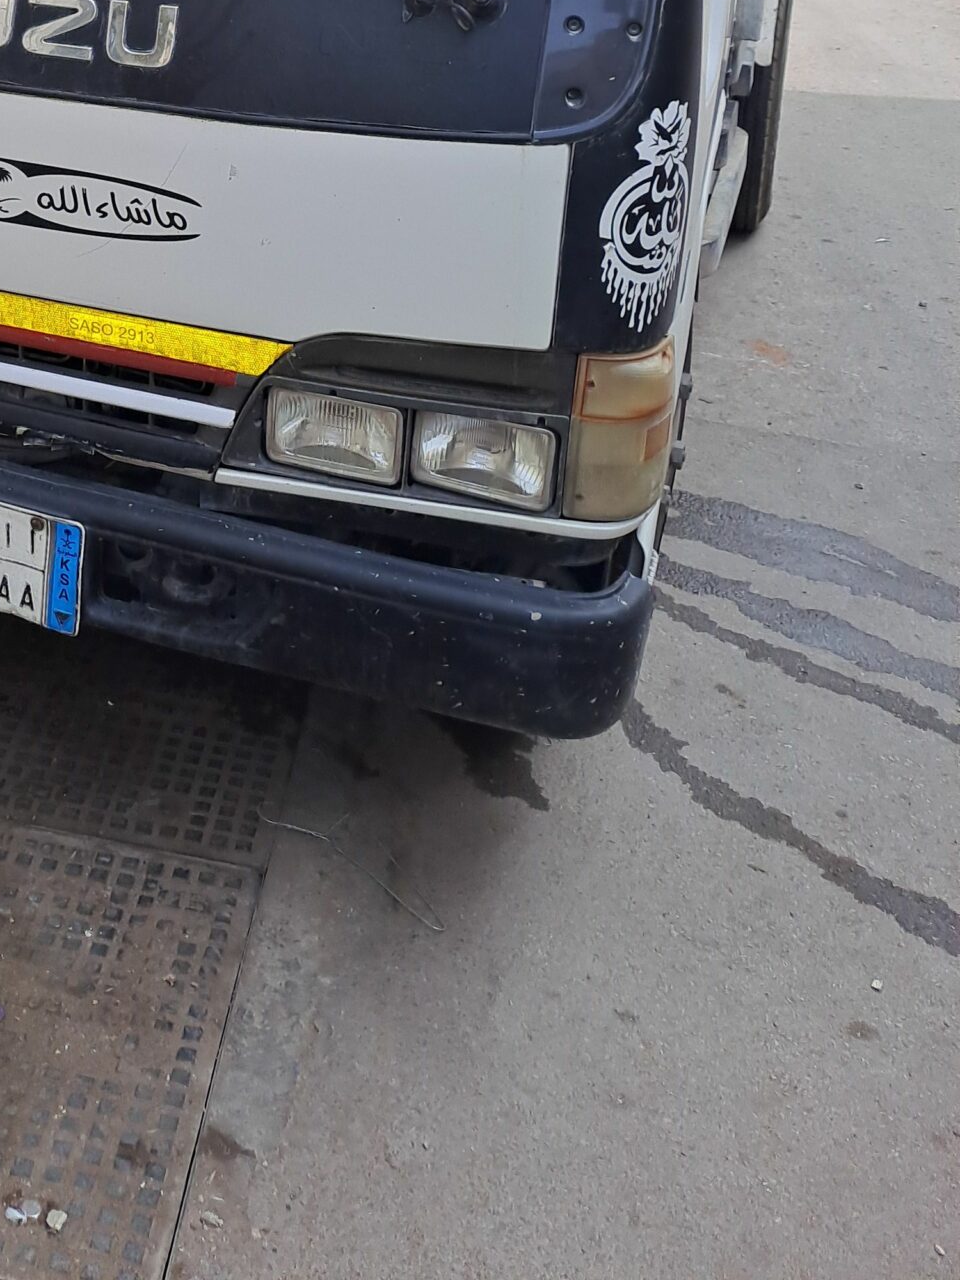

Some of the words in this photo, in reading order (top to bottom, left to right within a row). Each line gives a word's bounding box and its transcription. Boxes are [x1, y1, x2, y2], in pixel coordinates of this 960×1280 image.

[36, 184, 92, 214] الله
[68, 317, 114, 336] SASO
[118, 326, 155, 344] 2913
[58, 556, 71, 602] KSA
